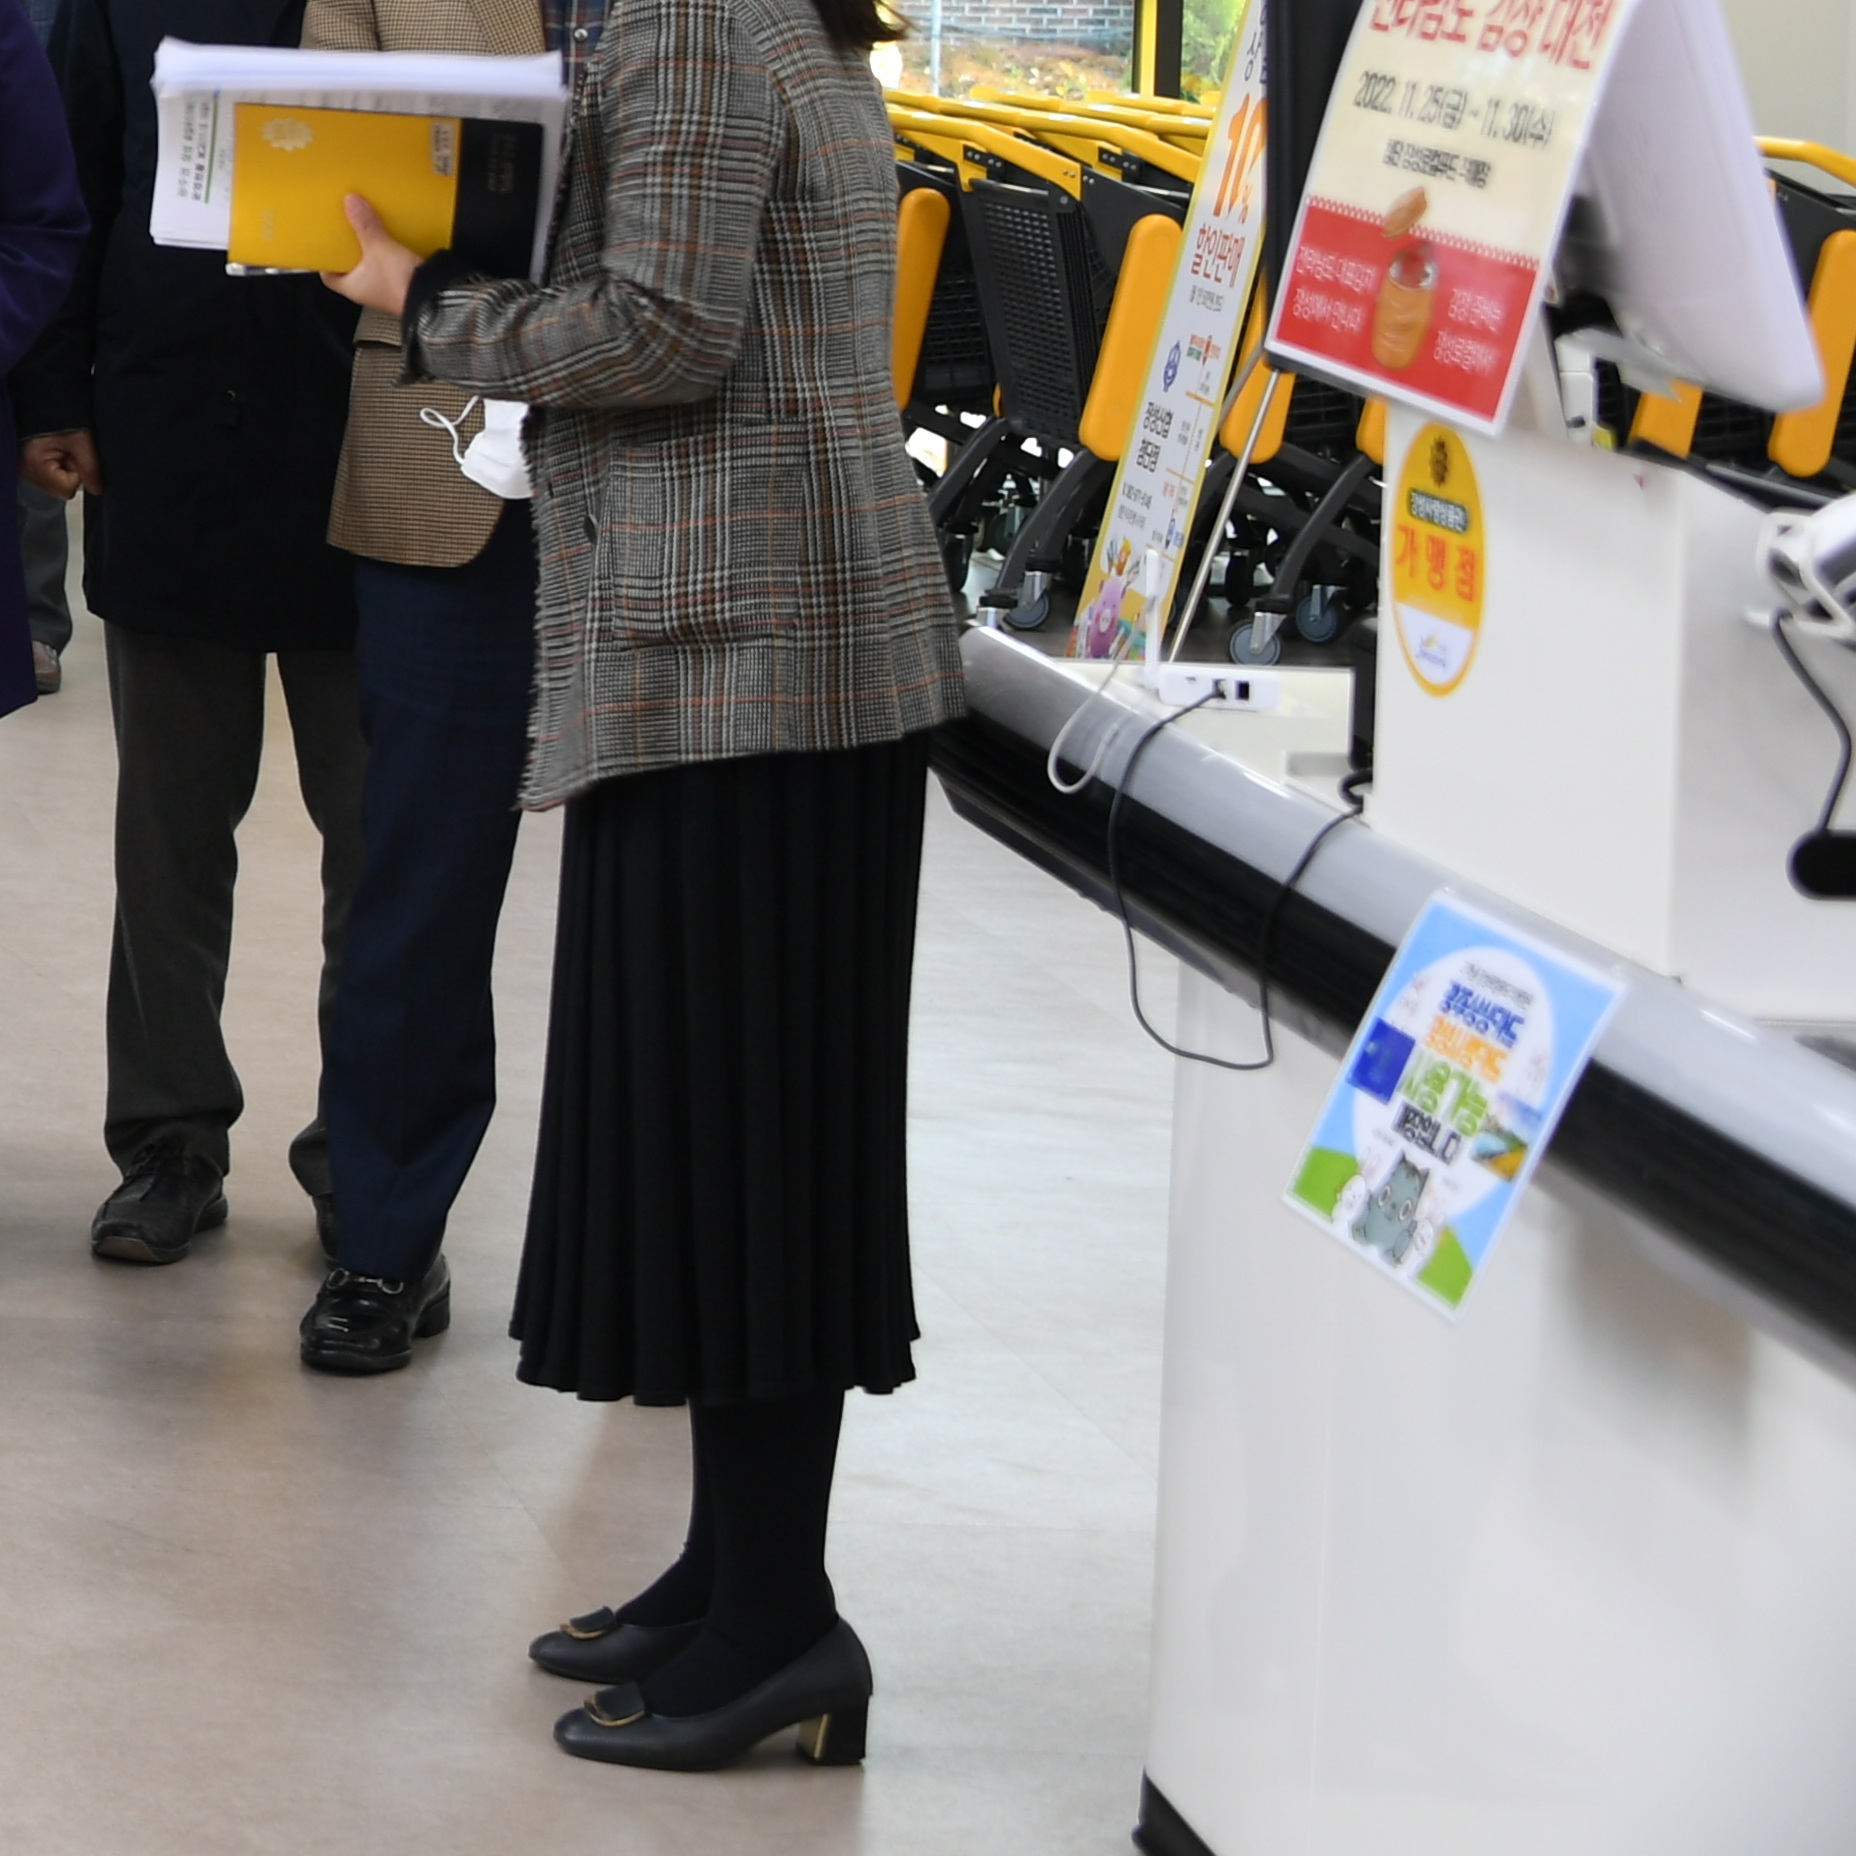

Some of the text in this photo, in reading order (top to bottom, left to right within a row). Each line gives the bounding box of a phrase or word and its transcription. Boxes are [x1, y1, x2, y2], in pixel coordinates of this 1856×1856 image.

[1353, 71, 1396, 115] 2022.
[1502, 102, 1555, 151] 30(수)
[1191, 222, 1245, 289] 할인판매
[1143, 402, 1173, 439] 장성신협
[1399, 1050, 1488, 1137] 사용가능
